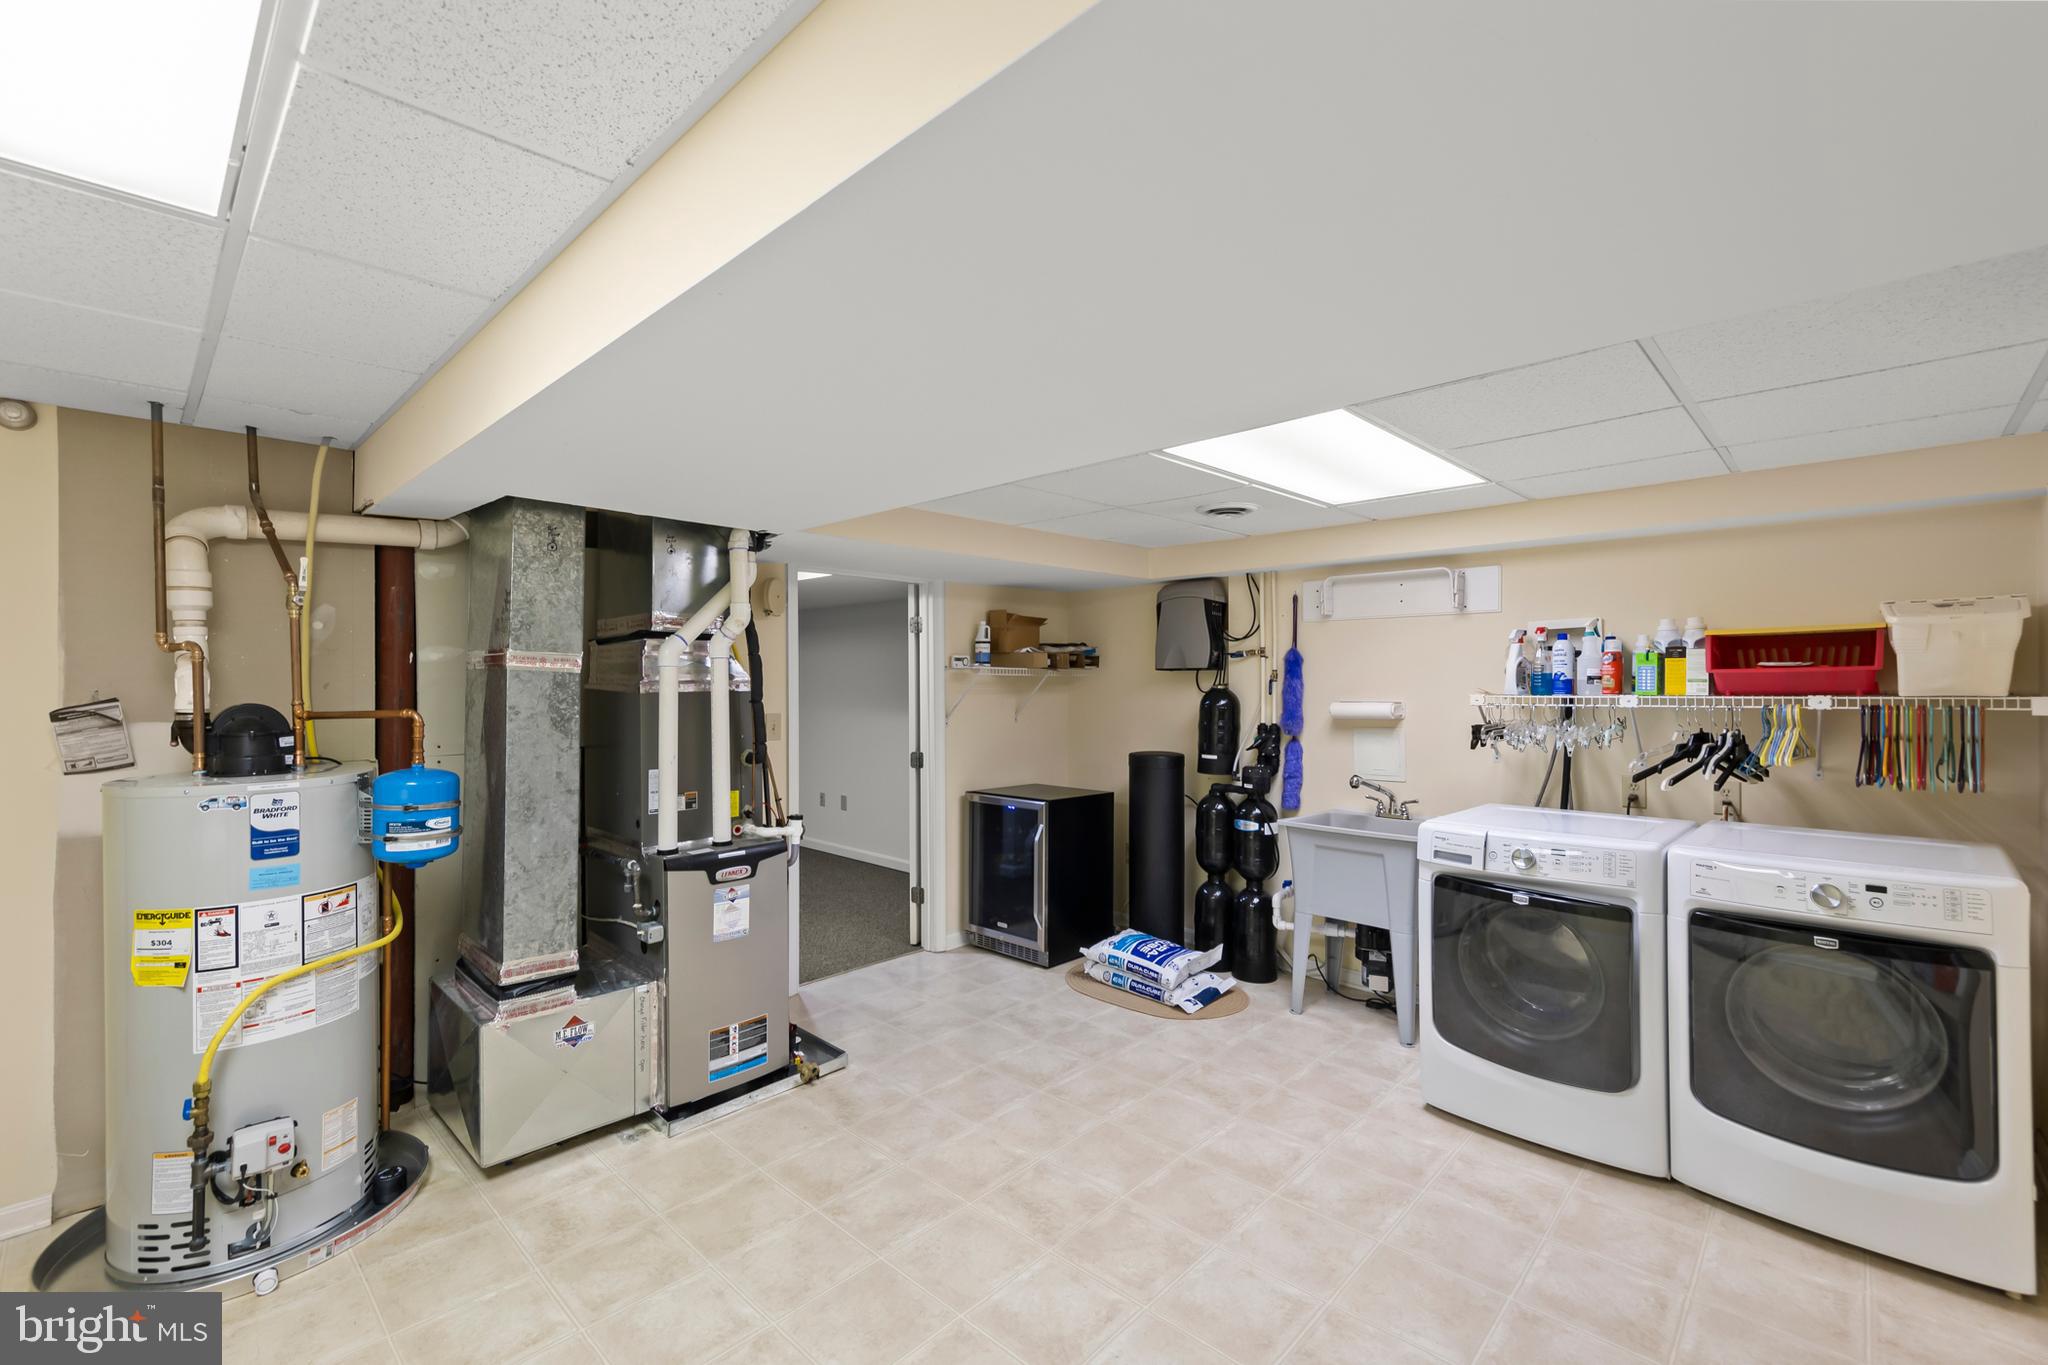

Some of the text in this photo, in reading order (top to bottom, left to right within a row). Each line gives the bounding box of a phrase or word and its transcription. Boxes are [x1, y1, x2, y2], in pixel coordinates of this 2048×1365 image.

[253, 805, 298, 814] BRADFORD
[150, 939, 173, 947] $304
[570, 1024, 589, 1036] FLOW
